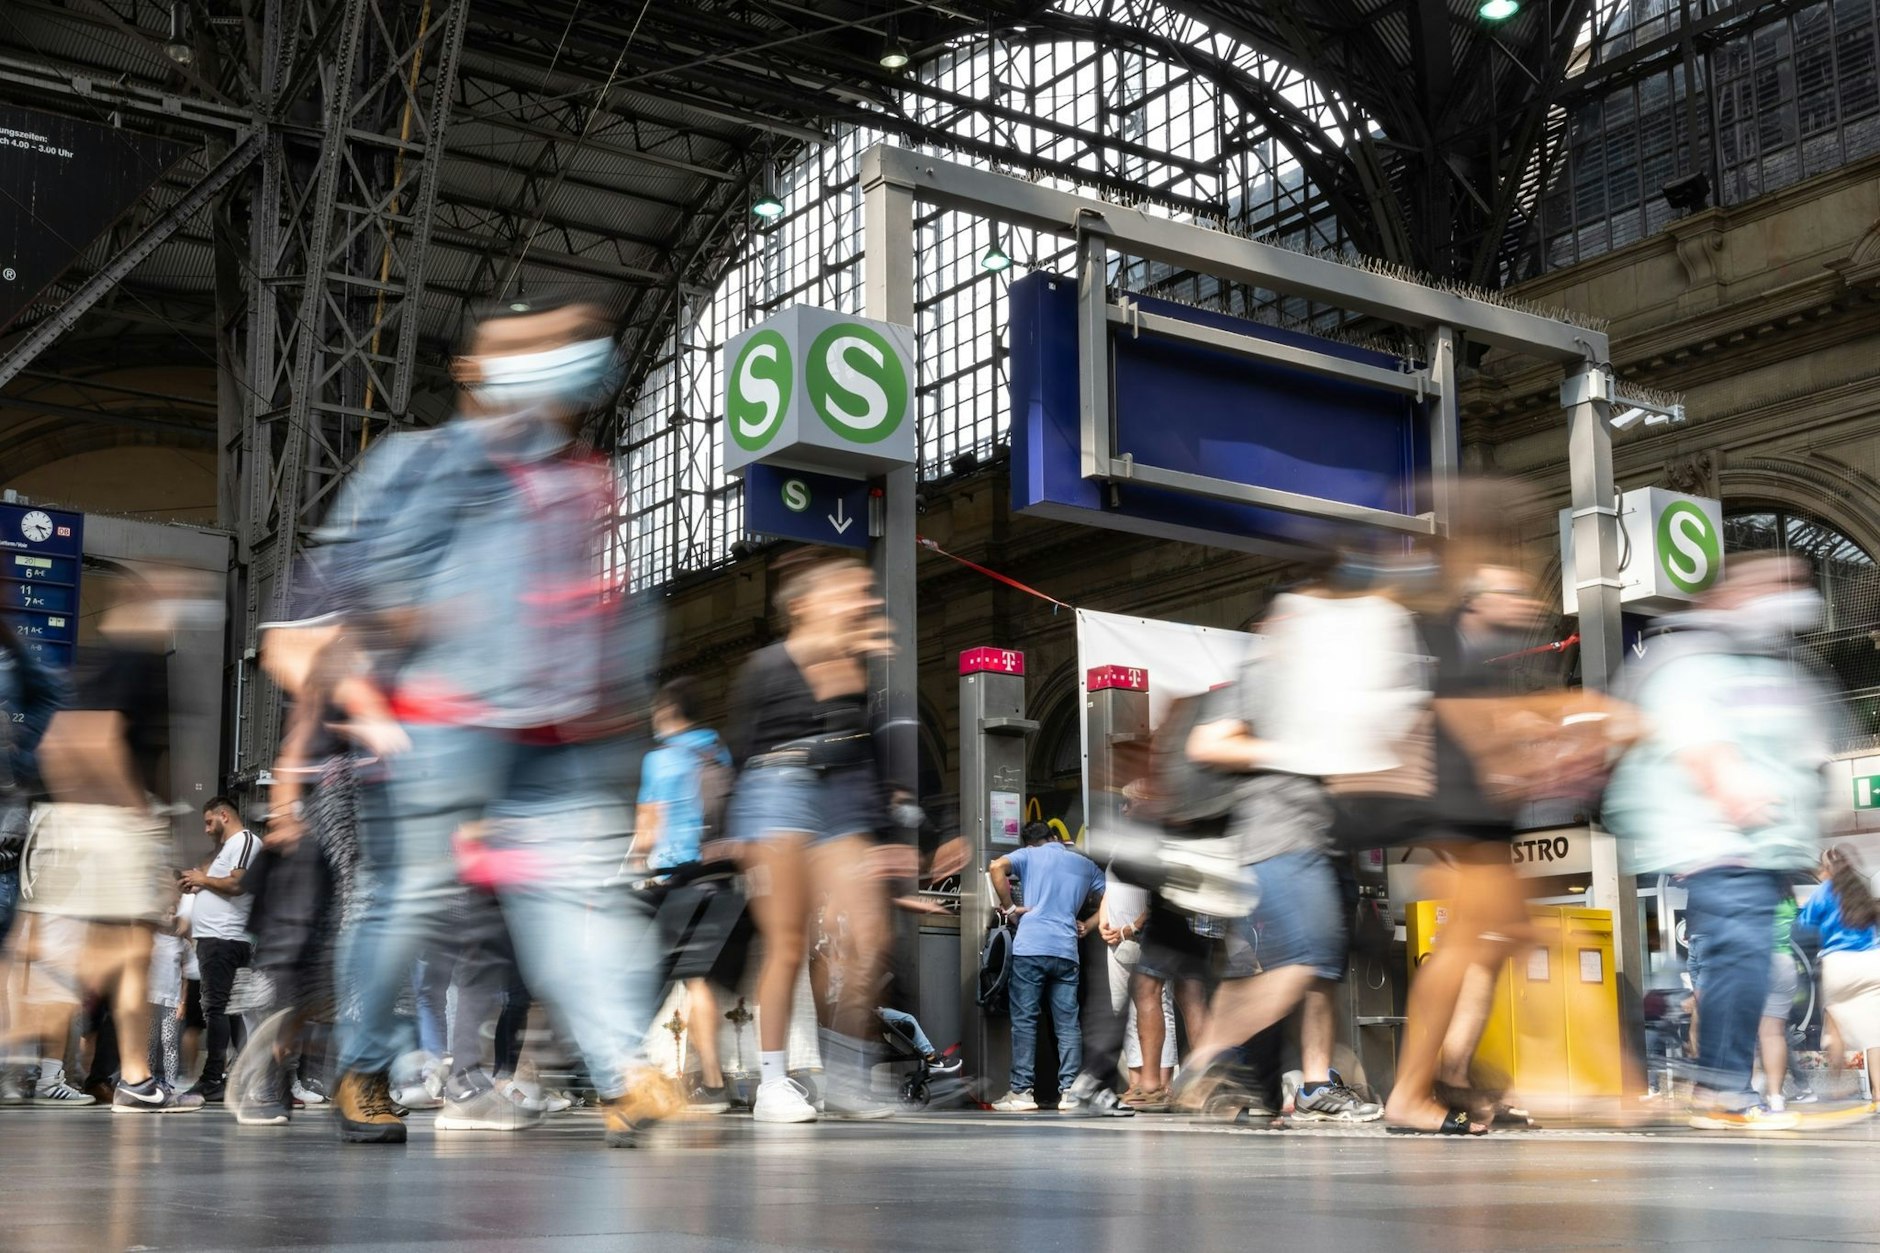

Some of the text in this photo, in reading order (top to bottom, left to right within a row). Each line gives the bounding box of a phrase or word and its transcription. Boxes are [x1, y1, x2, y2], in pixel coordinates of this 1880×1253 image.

[10, 139, 30, 149] 4.00
[38, 144, 56, 155] 3.00
[58, 148, 74, 158] Uhr
[739, 344, 780, 438] S
[825, 336, 888, 430] S
[785, 480, 807, 510] S
[1668, 510, 1709, 585] S
[26, 568, 33, 578] 6
[20, 584, 31, 595] 11
[24, 597, 31, 606] 7
[17, 625, 28, 635] 21
[1002, 651, 1016, 672] T
[1128, 668, 1141, 688] T
[12, 712, 25, 723] 22
